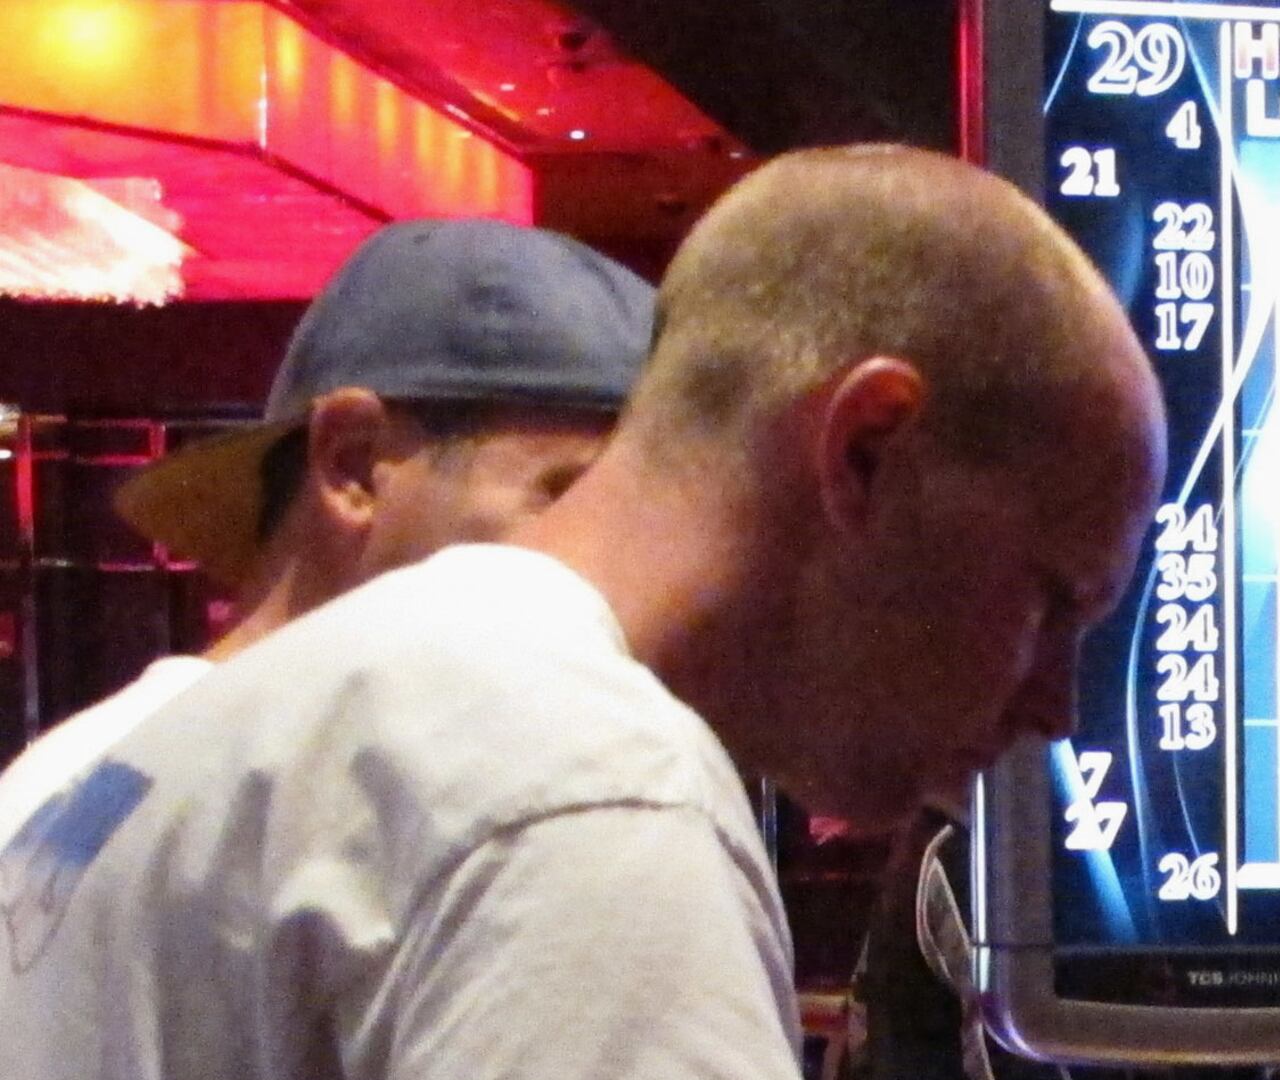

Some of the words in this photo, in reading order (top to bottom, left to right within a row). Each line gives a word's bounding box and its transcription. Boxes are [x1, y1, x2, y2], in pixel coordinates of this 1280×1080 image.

[1087, 21, 1186, 96] 29
[1166, 101, 1201, 149] 4
[1060, 147, 1120, 197] 21
[1153, 202, 1215, 250] 22
[1156, 252, 1214, 299] 10
[1156, 303, 1214, 350] 17
[1155, 504, 1217, 551] 24
[1156, 554, 1216, 601] 35
[1156, 604, 1218, 651] 24
[1156, 654, 1218, 701] 24
[1158, 704, 1216, 750] 13
[1078, 752, 1113, 800] 7
[1064, 802, 1127, 850] 27
[1157, 853, 1221, 900] 26
